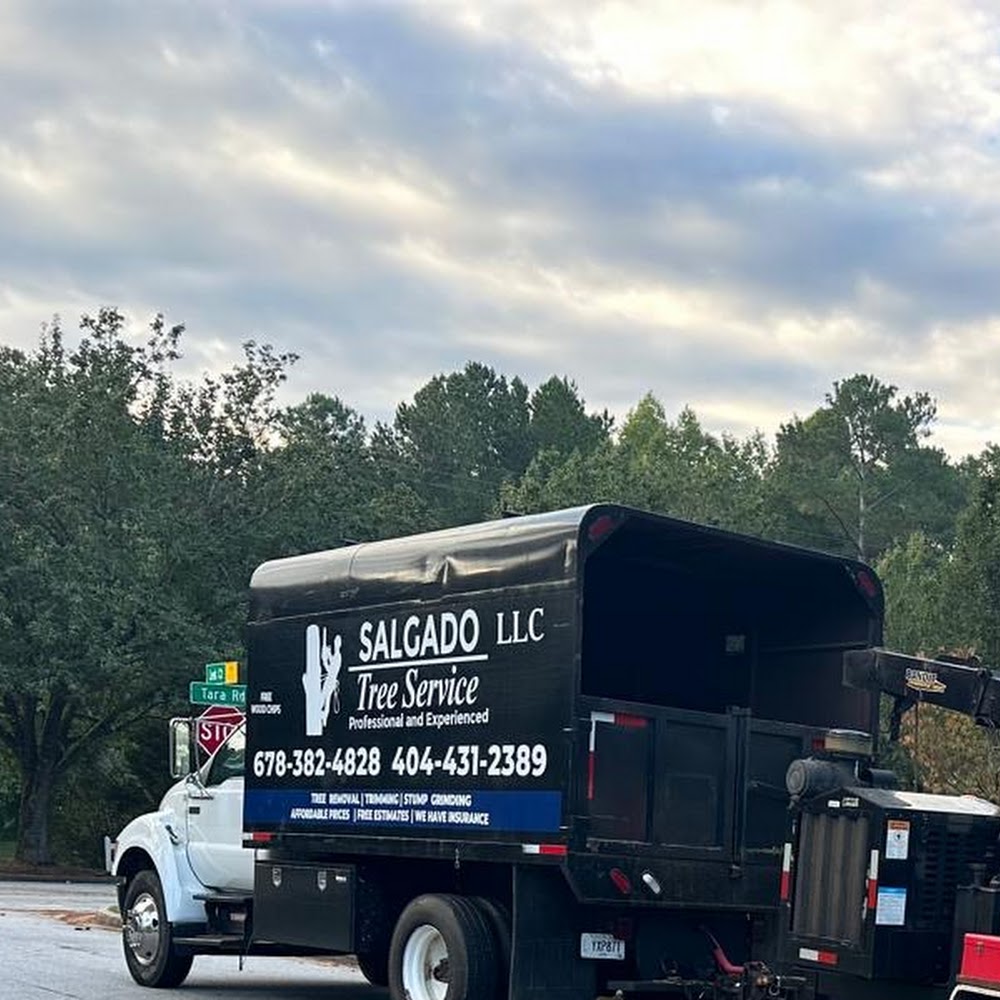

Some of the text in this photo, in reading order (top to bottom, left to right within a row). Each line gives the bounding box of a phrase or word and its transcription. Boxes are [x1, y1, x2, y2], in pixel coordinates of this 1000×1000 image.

[358, 607, 545, 663] SALGADO LLC
[201, 687, 246, 702] Tara Rd
[356, 664, 480, 711] Tree Service
[348, 707, 489, 730] Professional and Experienced
[253, 744, 548, 778] 678-382-4828 404-431-2389
[310, 792, 472, 807] TREE REMOVAL TRIMMING STUMP GRINDING
[290, 808, 490, 826] AFFORDABLE PRICES FREE ESTIMATES WE HAVE INSURANCE
